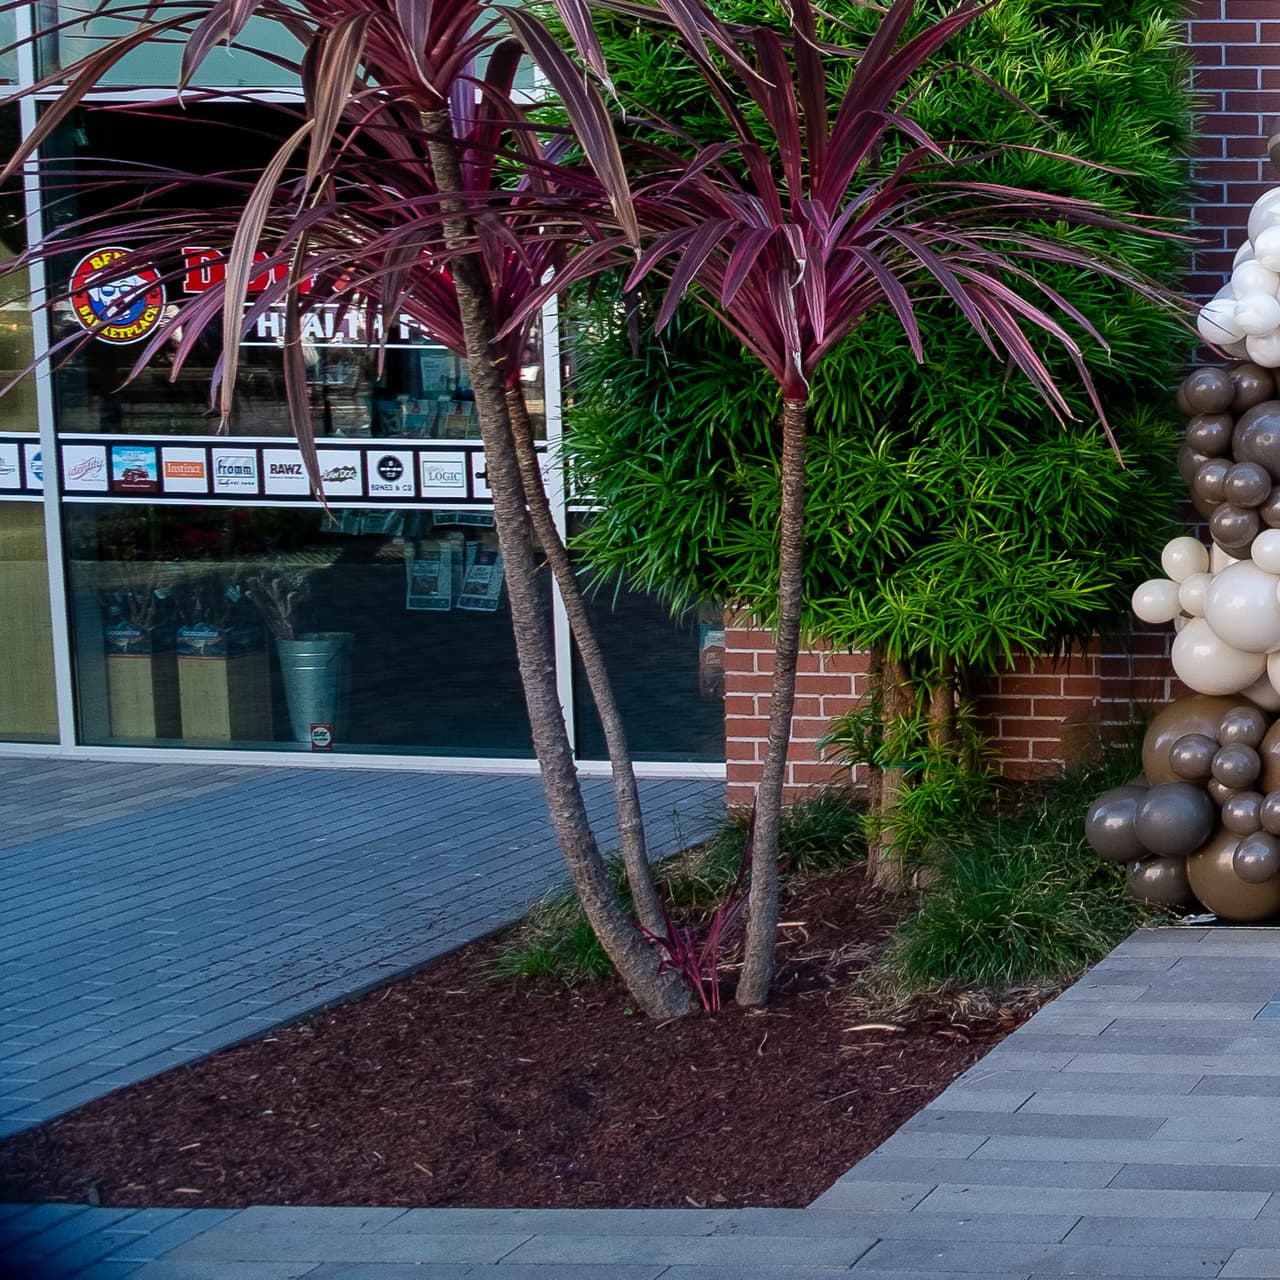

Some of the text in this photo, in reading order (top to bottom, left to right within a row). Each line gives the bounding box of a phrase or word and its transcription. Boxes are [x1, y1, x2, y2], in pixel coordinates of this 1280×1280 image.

[167, 463, 201, 473] Instinct
[217, 459, 251, 474] fromm
[270, 464, 302, 474] RAWZ
[429, 471, 462, 481] LOGIC
